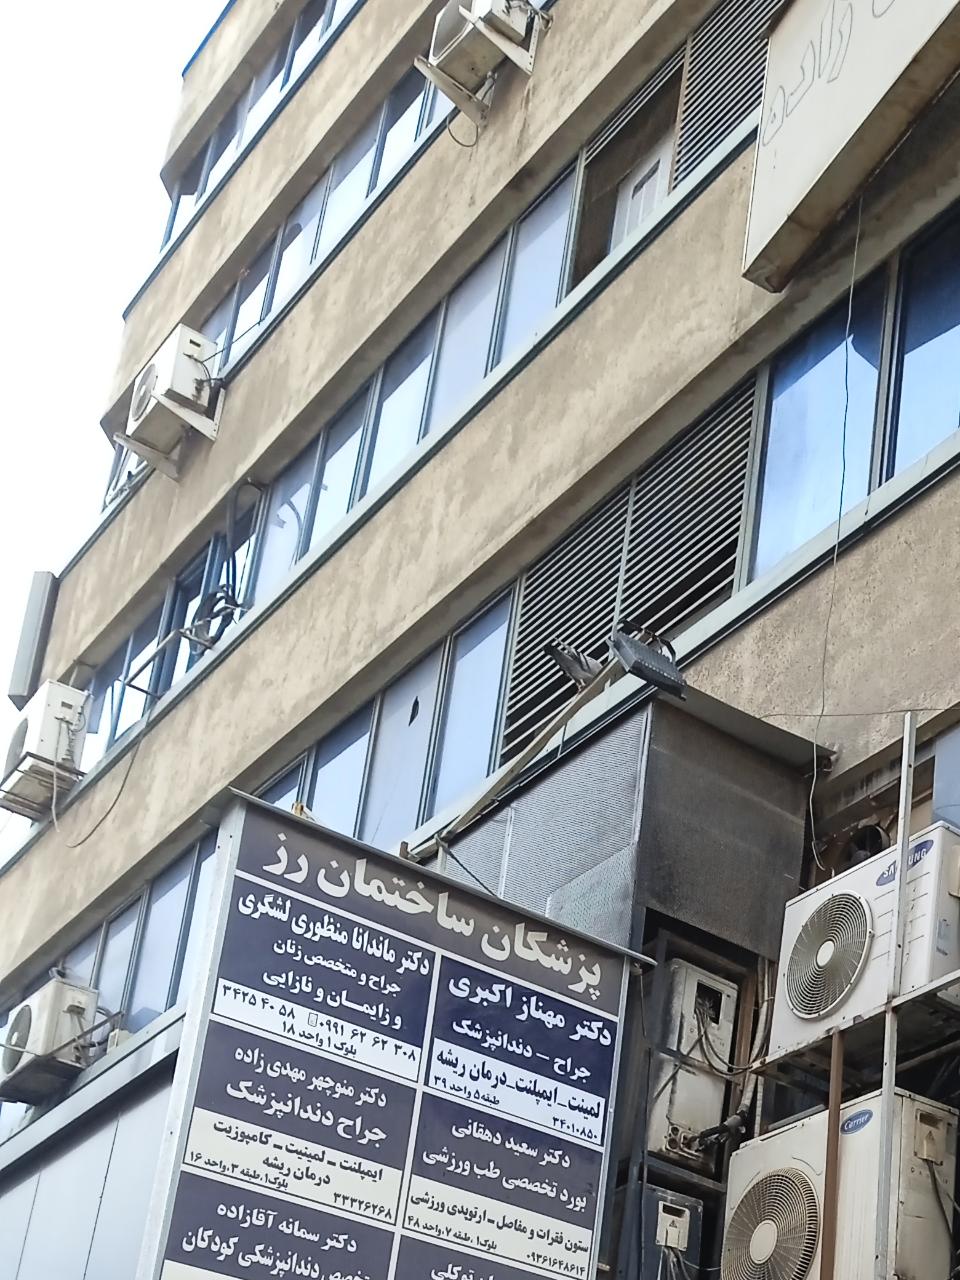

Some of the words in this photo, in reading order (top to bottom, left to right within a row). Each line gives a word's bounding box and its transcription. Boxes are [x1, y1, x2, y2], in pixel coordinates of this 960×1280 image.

[262, 832, 309, 883] رز
[883, 848, 928, 878] SAUNG
[316, 858, 475, 936] ساختمان
[291, 914, 348, 944] منظوری
[273, 938, 301, 961] زنان
[352, 926, 395, 962] ماندانا
[304, 952, 357, 979] متخصص
[396, 951, 430, 975] دکتر
[481, 923, 601, 1000] پزشکان
[263, 971, 312, 993] نازایی
[359, 973, 367, 984] و
[368, 975, 401, 997] جراح
[314, 988, 323, 1002] و
[449, 978, 512, 1007] اکبری
[392, 1015, 402, 1029] و
[516, 996, 566, 1028] مهناز
[283, 1020, 295, 1035] ۱۸
[299, 1031, 323, 1047] واحد
[452, 1020, 533, 1057] دندانپزشک
[569, 1020, 612, 1046] دکتر
[235, 1047, 265, 1073] زاده
[334, 1042, 357, 1058] بلوک
[267, 1061, 306, 1082] مهدی
[437, 1049, 465, 1077] ریشه
[553, 1057, 591, 1083] جراح
[307, 1073, 354, 1098] منوچهر
[434, 1075, 446, 1089] ۳۹
[450, 1082, 471, 1098] واحد
[226, 1080, 334, 1125] دندانپزشک
[355, 1086, 387, 1107] دکتر
[213, 1120, 272, 1145] کامپوزیت
[337, 1116, 387, 1148] جراح
[452, 1119, 501, 1145] دهقانی
[552, 1116, 598, 1139] ۳۴۰۱۰۸۵۰
[844, 1113, 869, 1130] Carrier
[190, 1151, 202, 1162] ۱۶
[285, 1141, 325, 1163] لمینیت
[505, 1137, 538, 1158] سعید
[539, 1149, 571, 1168] دکتر
[263, 1155, 291, 1177] ریشه
[340, 1159, 384, 1182] ایمپلنت
[423, 1146, 471, 1176] ورزشی
[473, 1161, 500, 1179] طب
[294, 1167, 331, 1187] درمان
[502, 1175, 558, 1198] تخصصی
[334, 1192, 392, 1219] ۳۳۳۲۶۲۶۸
[411, 1192, 445, 1213] ورزشی
[560, 1188, 587, 1213] بورد
[217, 1203, 278, 1228] آقازاده
[408, 1216, 420, 1228] ۴۸
[496, 1215, 527, 1234] مفاصل
[279, 1218, 320, 1242] سمانه
[528, 1229, 535, 1239] و
[536, 1227, 563, 1246] فقرات
[182, 1227, 239, 1260] کودکان
[321, 1233, 357, 1252] دکتر
[565, 1238, 589, 1253] ستون
[238, 1244, 320, 1278] دندانپزشکی
